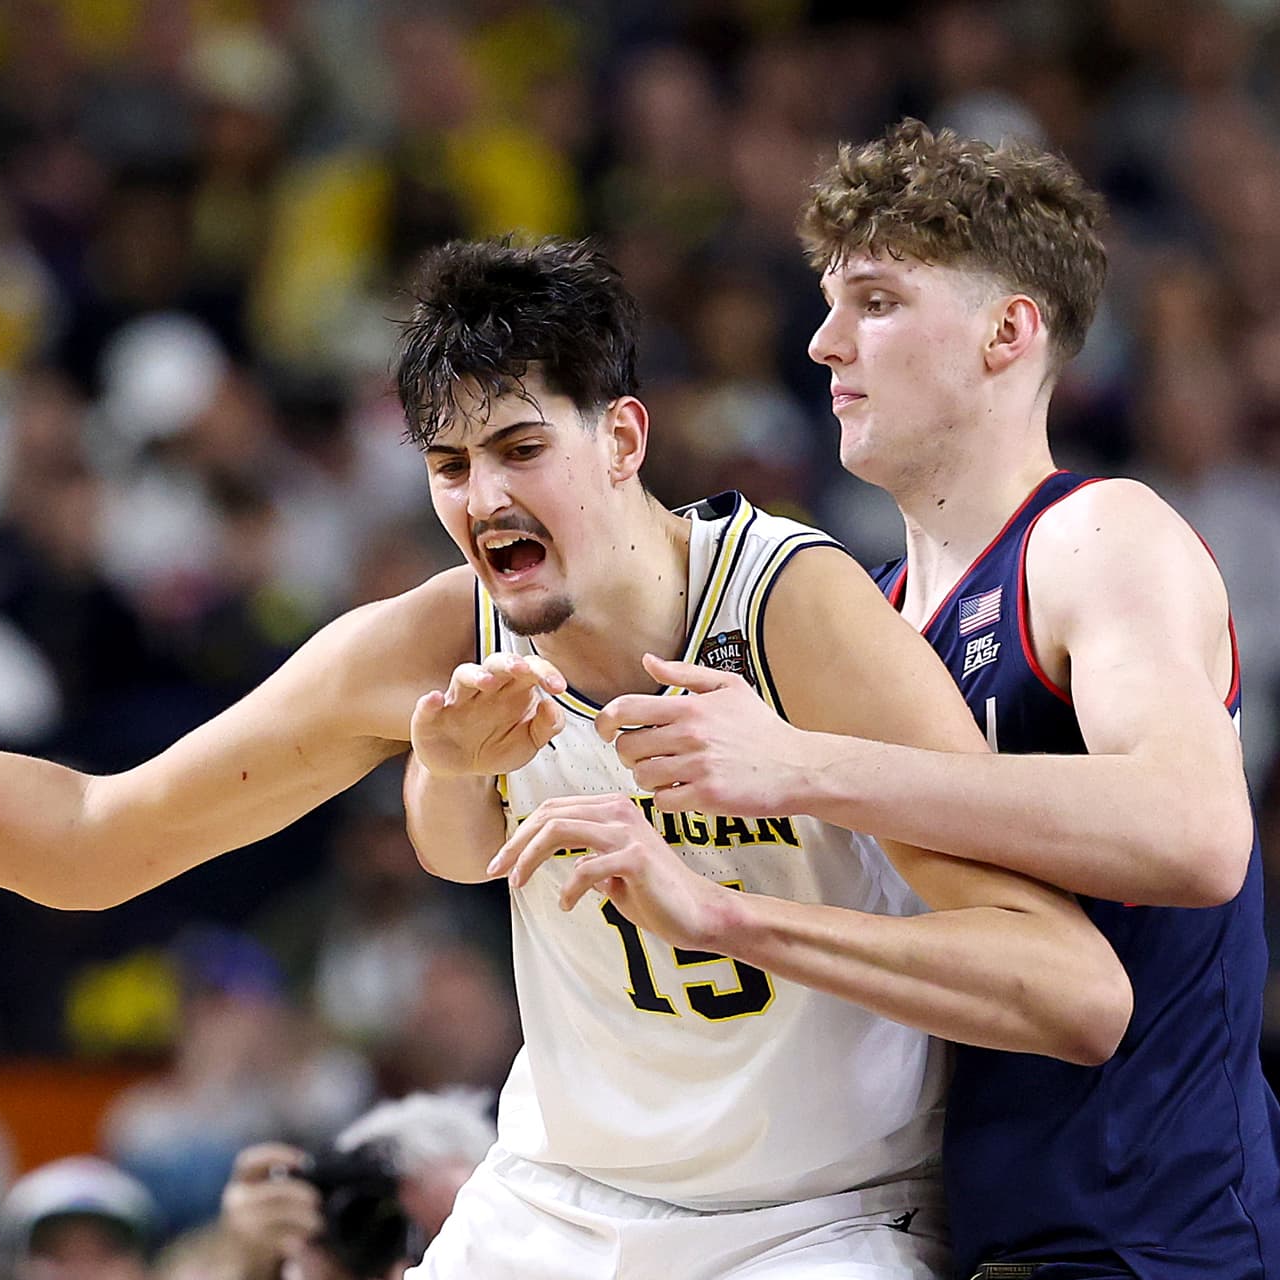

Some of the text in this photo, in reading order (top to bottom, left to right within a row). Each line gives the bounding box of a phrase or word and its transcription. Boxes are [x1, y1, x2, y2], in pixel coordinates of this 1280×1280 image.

[707, 644, 741, 665] FINAL
[963, 643, 1001, 671] EAST
[966, 632, 995, 656] BIG
[599, 879, 776, 1022] 15
